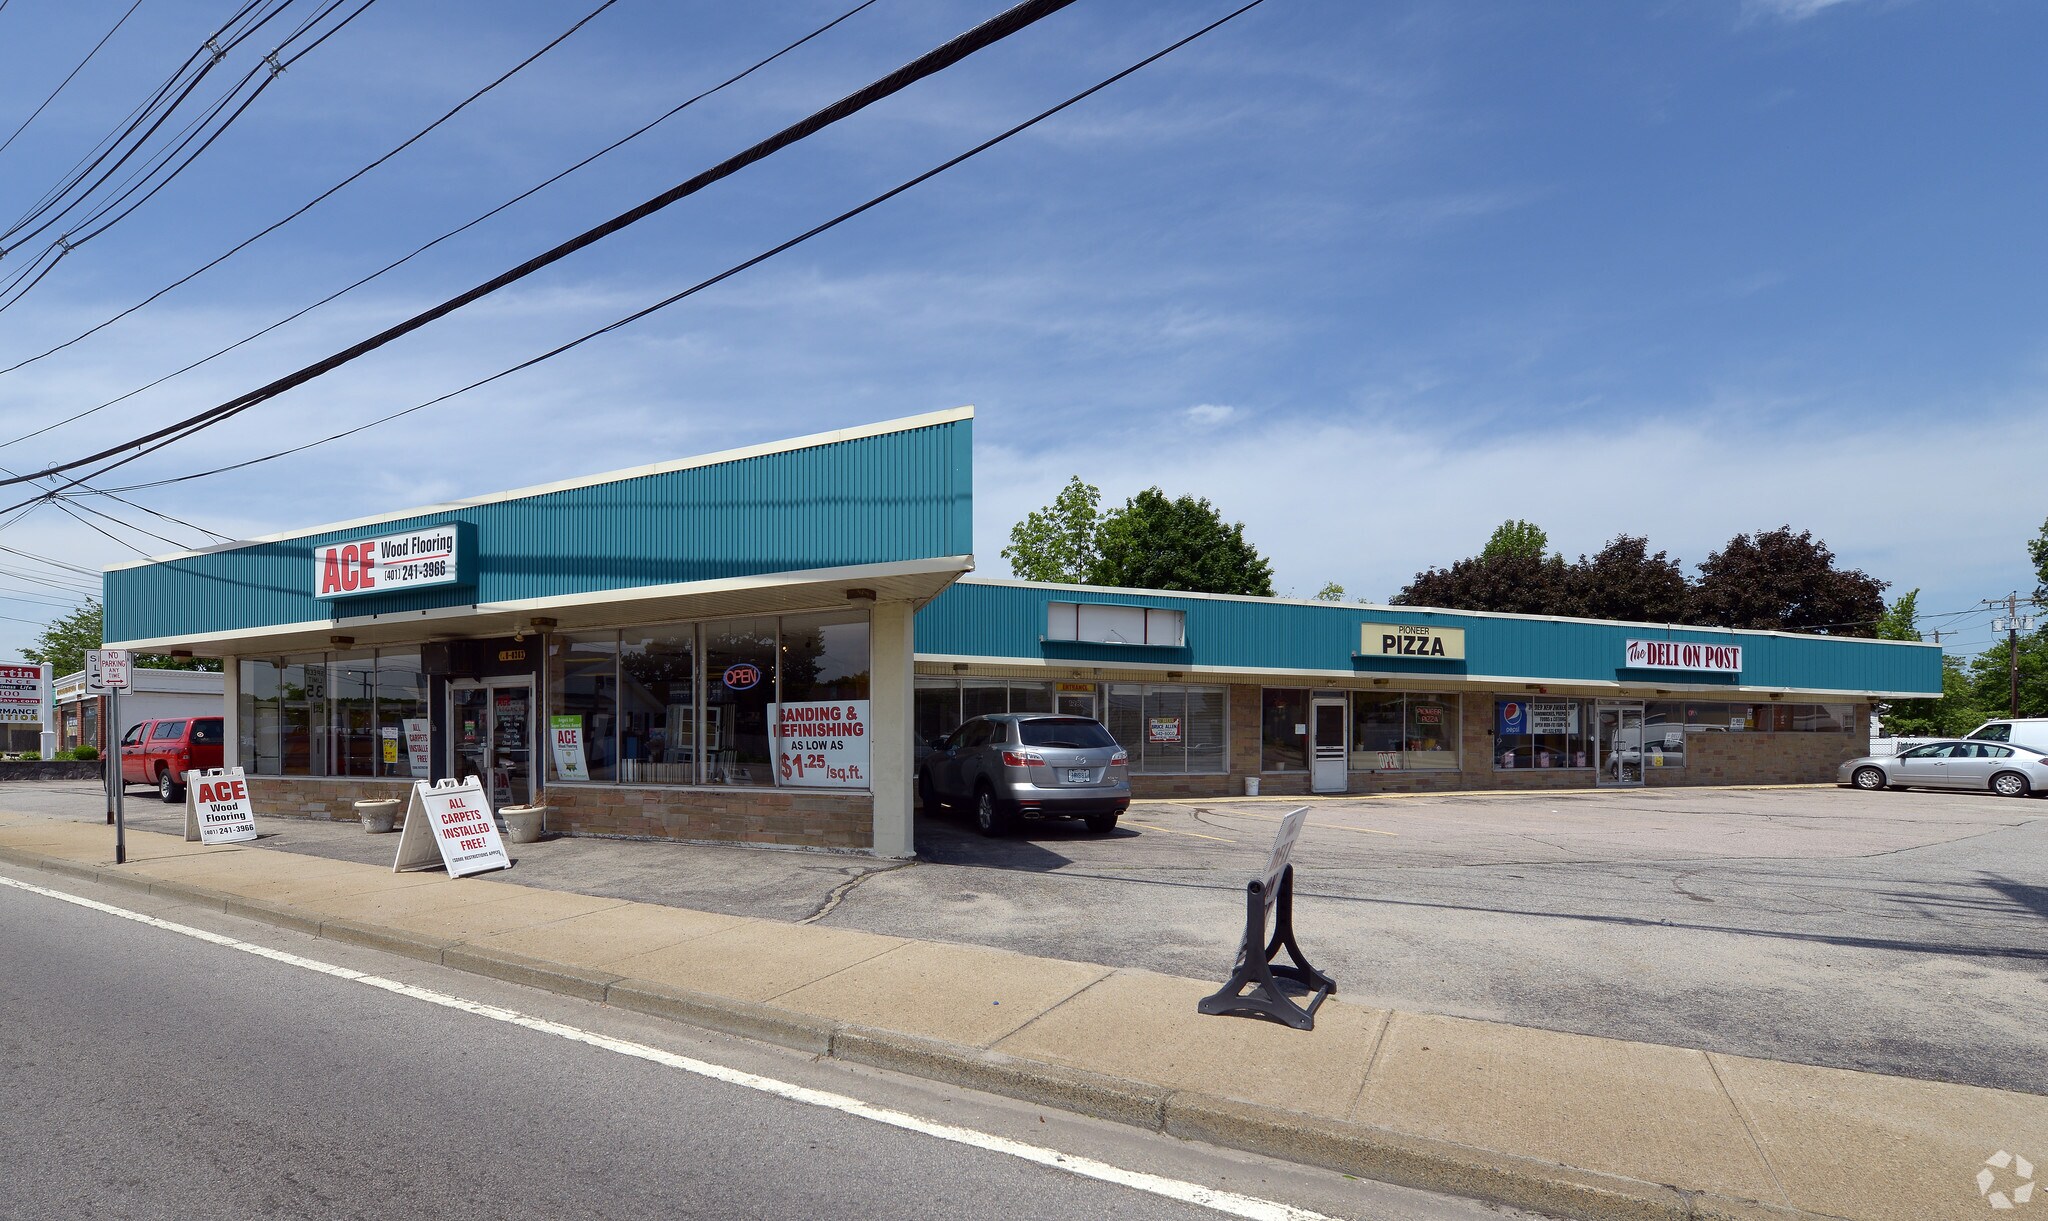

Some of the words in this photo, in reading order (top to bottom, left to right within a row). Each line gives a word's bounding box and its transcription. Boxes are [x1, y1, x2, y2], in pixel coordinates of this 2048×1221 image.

[381, 538, 408, 559] Wood
[411, 533, 453, 554] Flooring
[322, 541, 375, 594] ACE
[402, 560, 446, 581] 241-3966
[1398, 625, 1430, 635] PIONEER
[1382, 635, 1445, 656] PIZZA
[108, 651, 119, 659] NO
[1627, 641, 1646, 663] The
[1647, 642, 1679, 666] DELI
[1682, 645, 1701, 668] ON
[1705, 646, 1740, 669] POST
[102, 660, 126, 668] PARKING
[726, 669, 756, 685] OPEN
[779, 706, 841, 722] SANDING
[846, 705, 858, 721] &
[1416, 708, 1442, 716] PIONEER
[1421, 715, 1439, 723] PIZZA
[412, 723, 421, 731] ALL
[409, 734, 428, 742] CARPETS
[558, 730, 577, 744] ACE
[409, 744, 428, 752] INSTALLE
[791, 741, 804, 750] AS
[806, 740, 828, 750] LOW
[830, 740, 844, 750] AS
[1378, 752, 1400, 769] OPEN
[199, 780, 246, 804] ACE
[210, 802, 239, 812] Wood
[449, 798, 466, 809] ALL
[206, 812, 246, 823] Flooring
[441, 809, 482, 825] CARPETS
[219, 824, 254, 835] 241-3966
[442, 822, 490, 839] INSTALLED
[460, 837, 487, 851] FREE!
